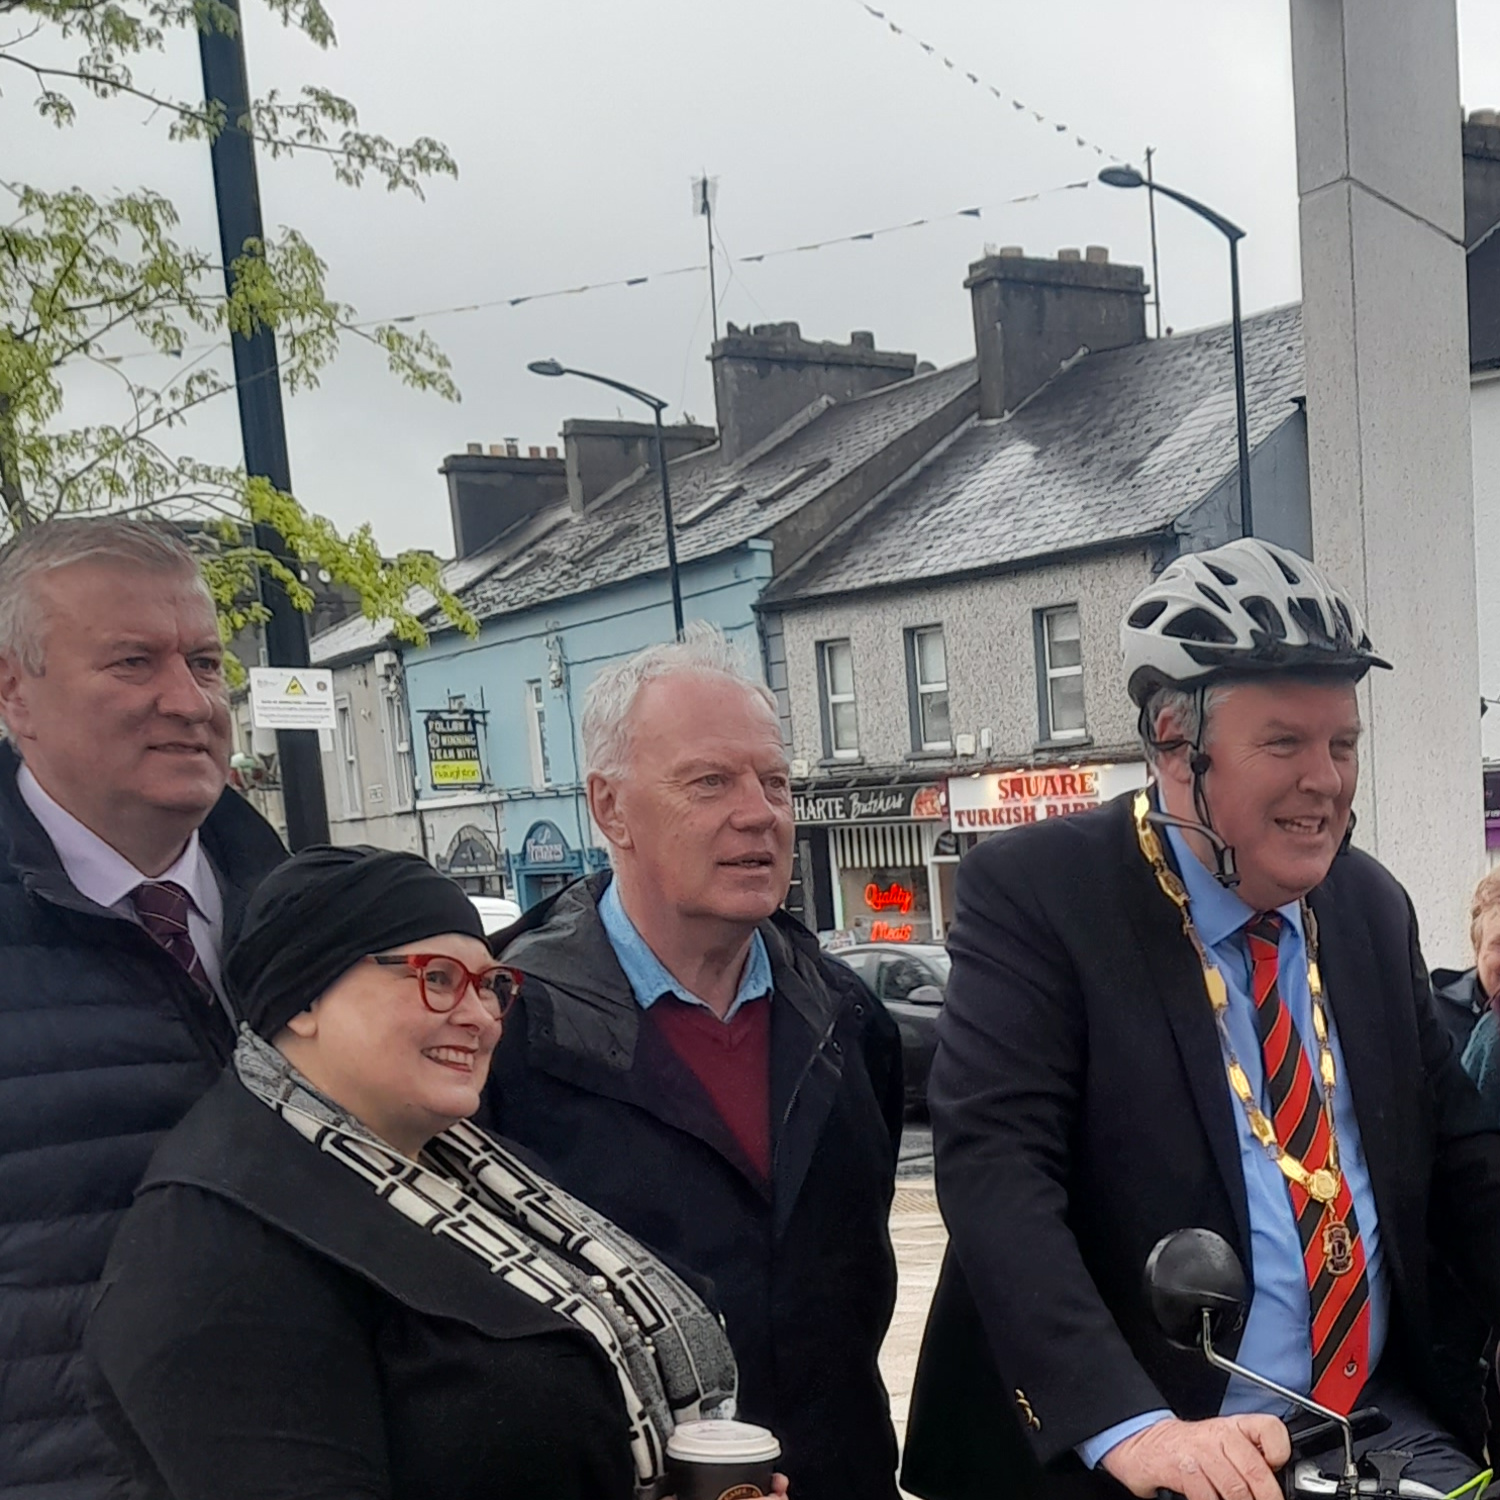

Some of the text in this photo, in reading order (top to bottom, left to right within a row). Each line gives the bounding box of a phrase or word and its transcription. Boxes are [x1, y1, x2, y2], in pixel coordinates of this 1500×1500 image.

[428, 720, 465, 732] FOLLOW
[430, 748, 478, 760] TEAM WITH
[794, 796, 847, 821] HARTE
[954, 807, 1036, 827] TURKISH
[865, 882, 912, 914] Quality
[870, 920, 912, 942] Meats
